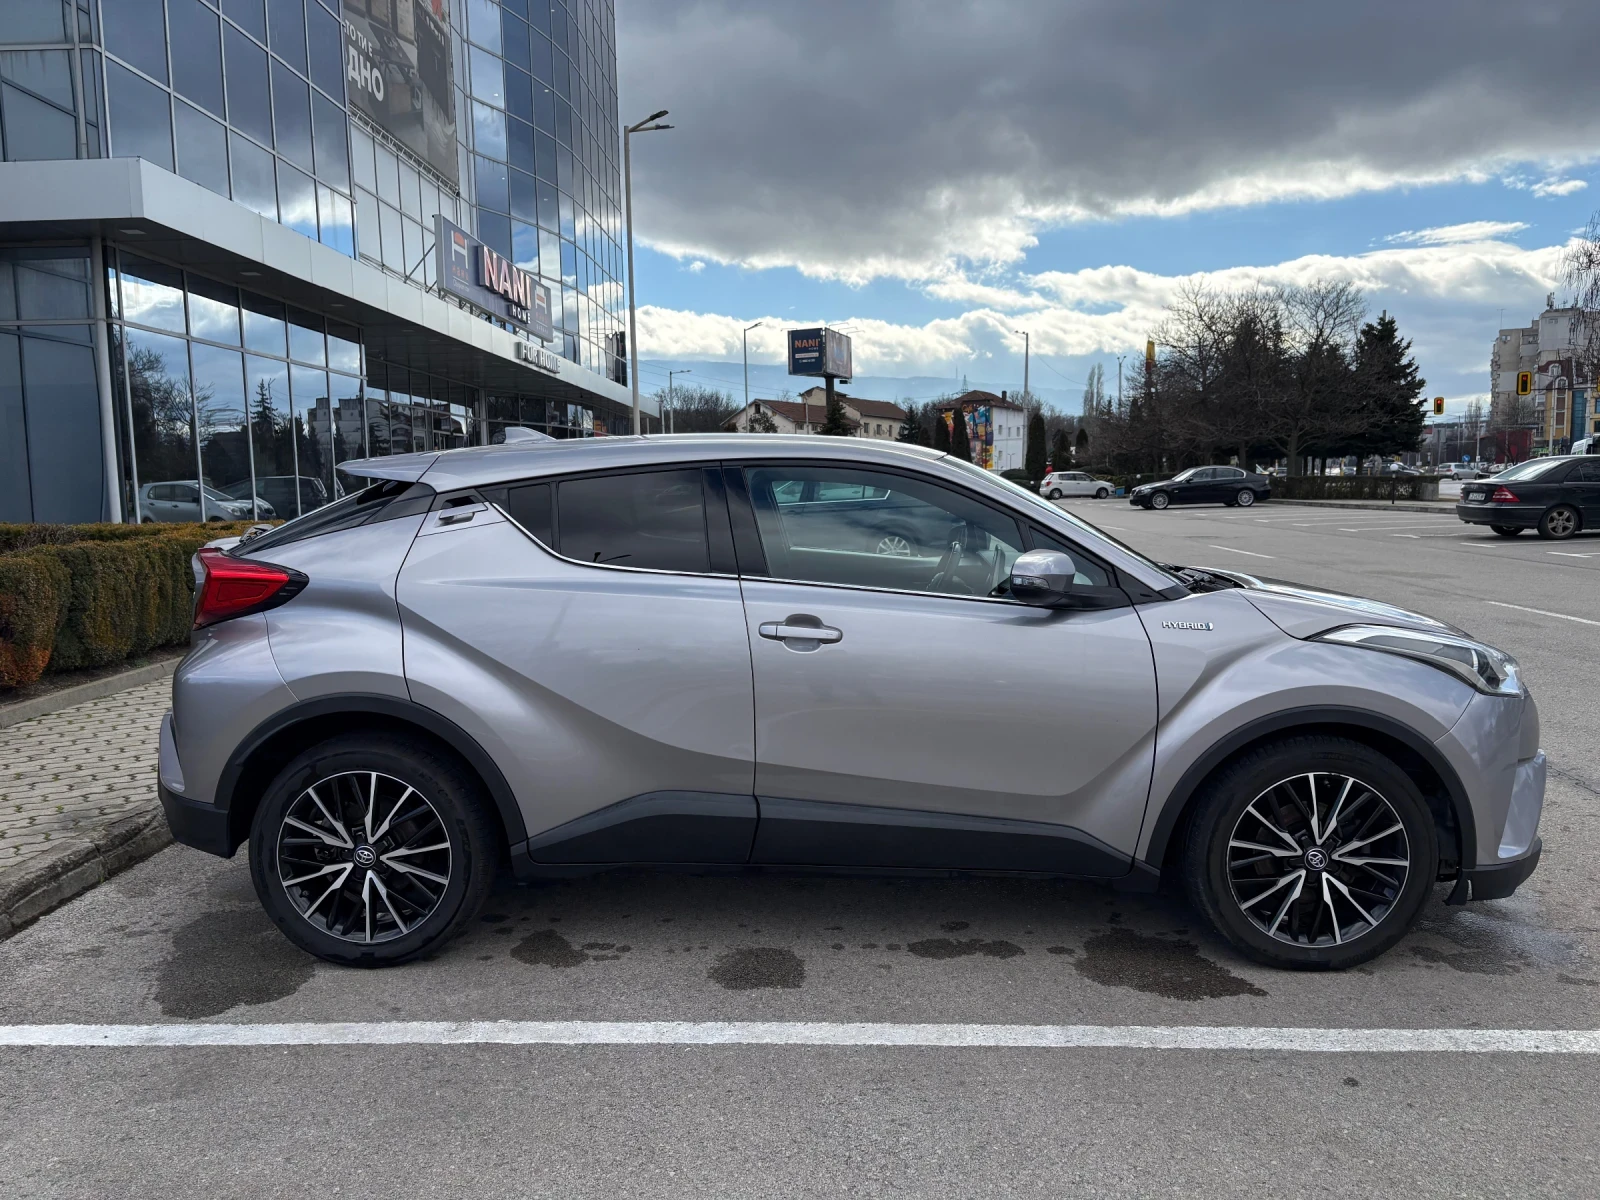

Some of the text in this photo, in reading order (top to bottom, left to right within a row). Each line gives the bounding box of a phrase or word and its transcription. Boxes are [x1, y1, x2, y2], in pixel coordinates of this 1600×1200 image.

[344, 19, 356, 41] ТО
[483, 245, 532, 310] NANI
[512, 303, 531, 324] HOME
[795, 339, 818, 348] NANI
[522, 343, 561, 373] FOR HOME
[1162, 620, 1206, 630] HYBRID
